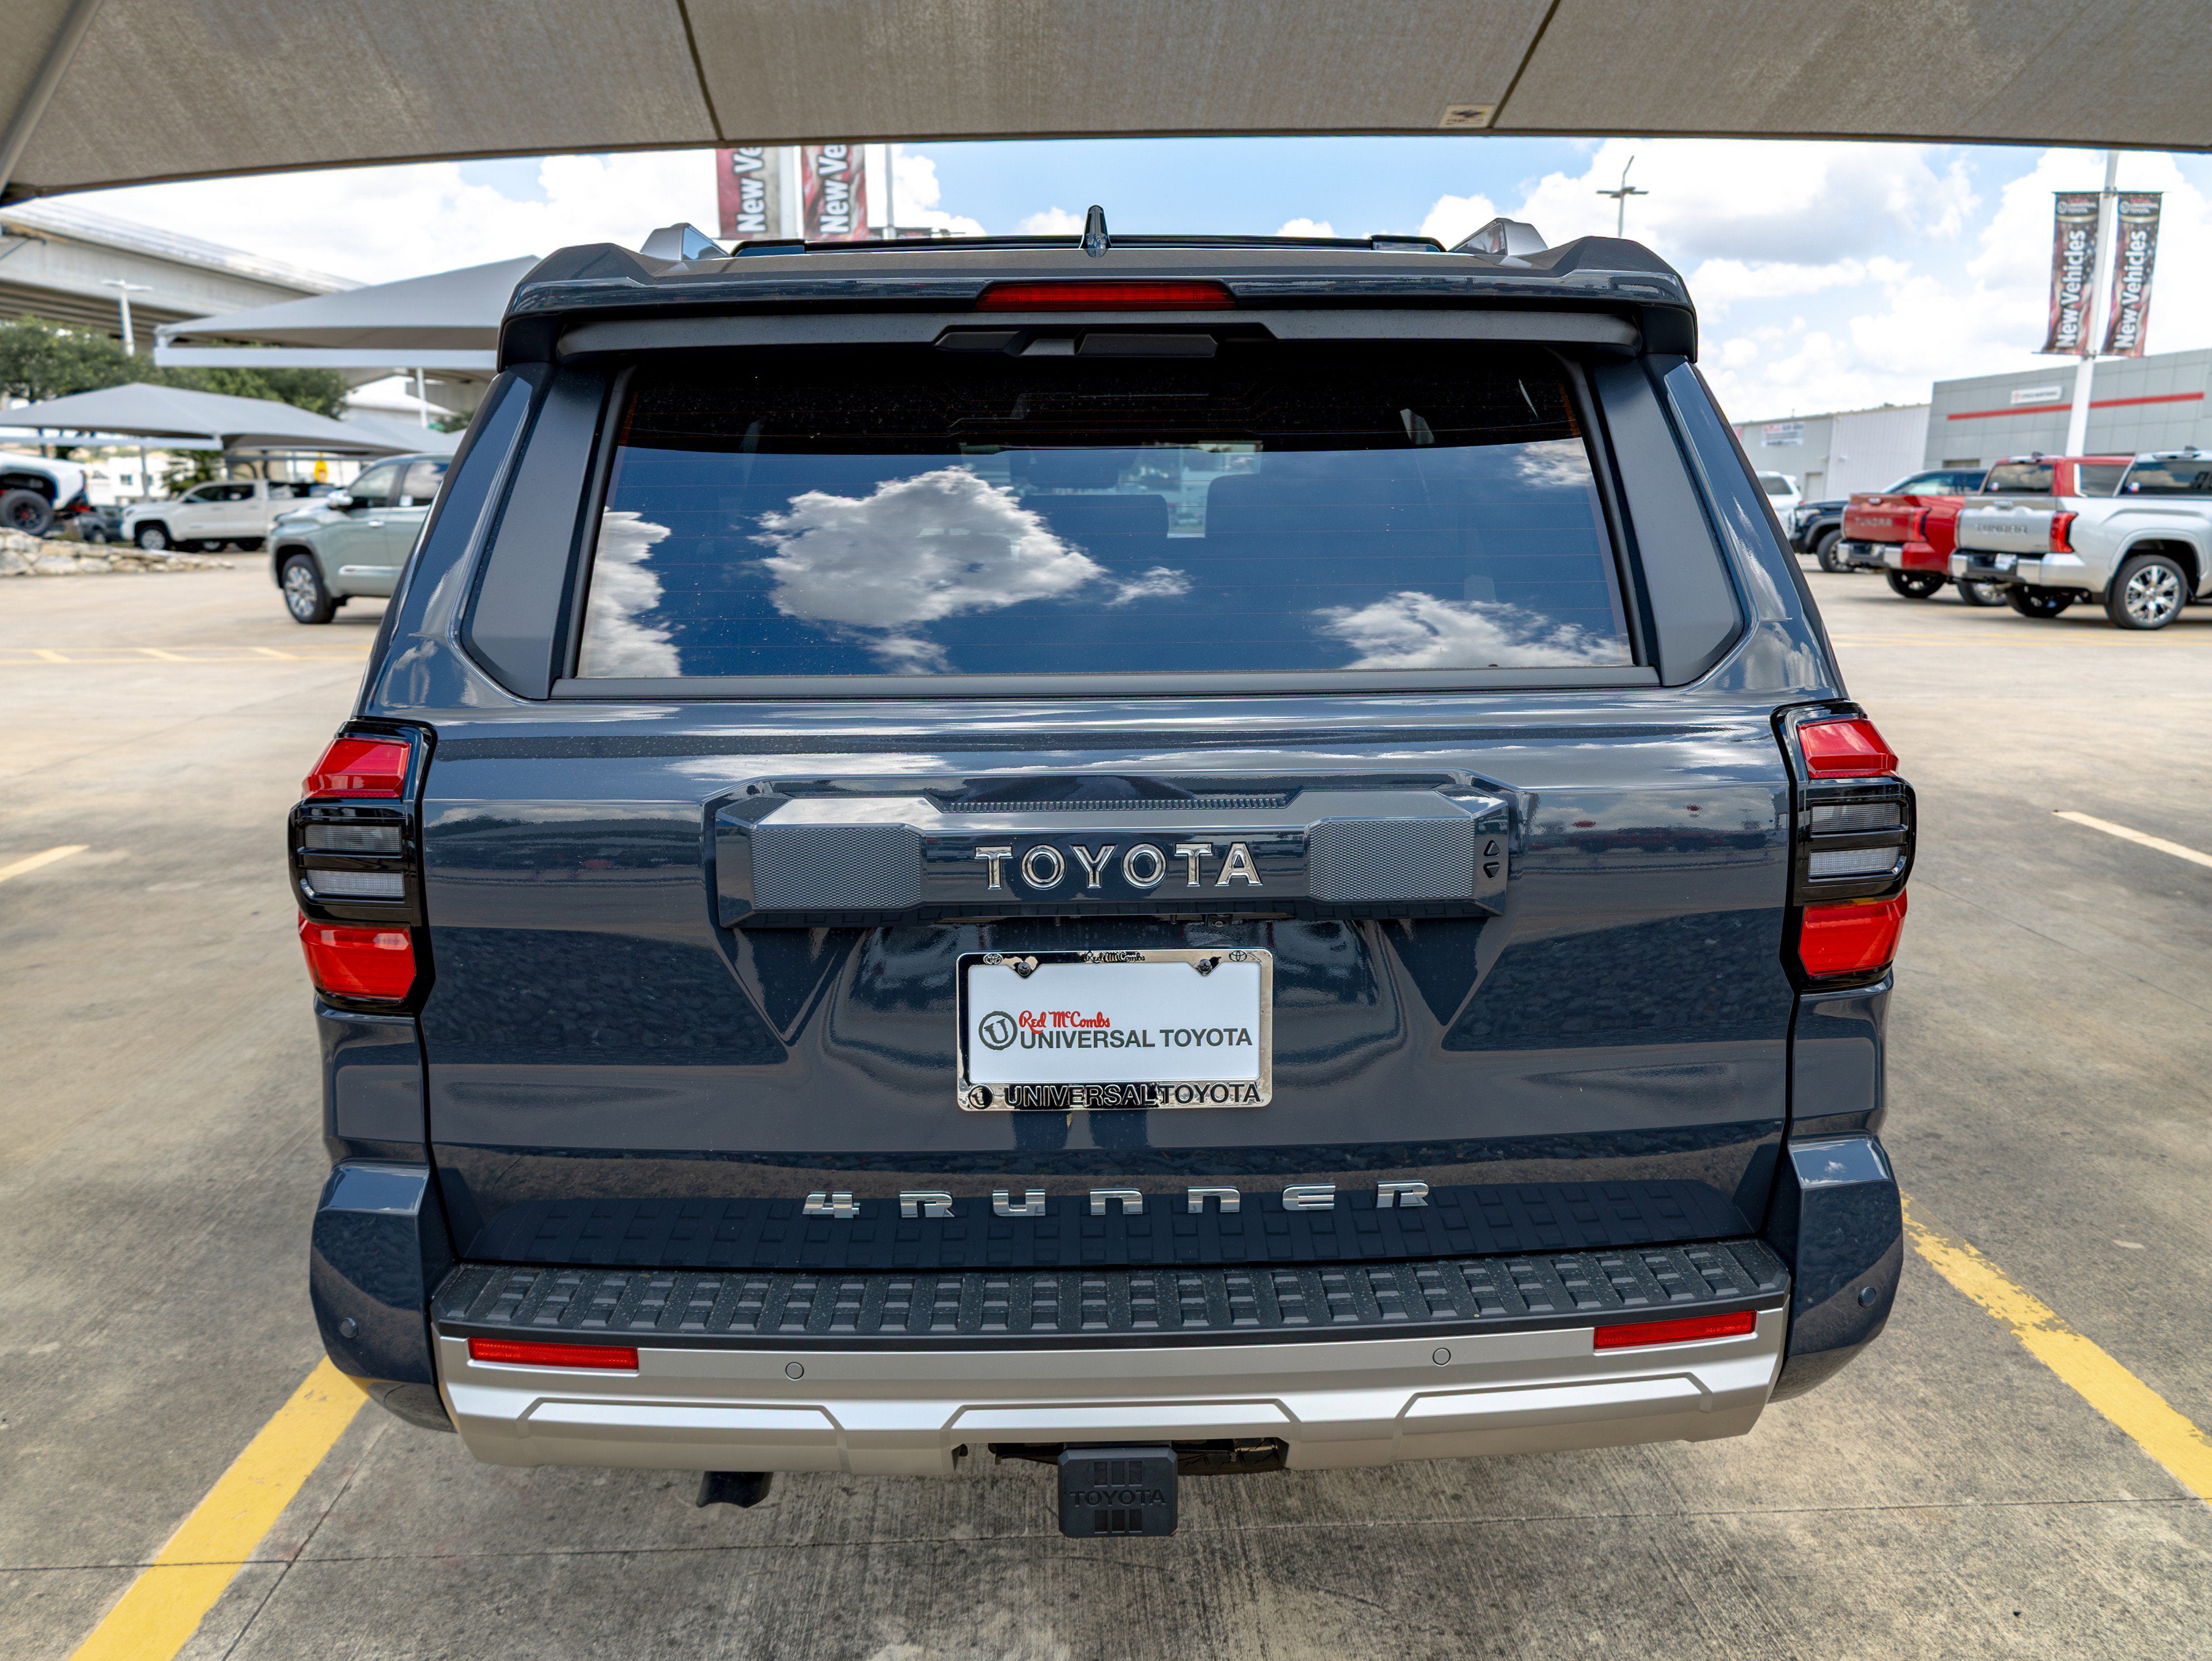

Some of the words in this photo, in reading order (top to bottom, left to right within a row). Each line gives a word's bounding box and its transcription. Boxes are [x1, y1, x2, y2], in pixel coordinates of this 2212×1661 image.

[737, 178, 766, 232] New
[820, 179, 849, 233] New
[2061, 230, 2086, 305] Vehicles
[2122, 230, 2147, 305] Vehicles
[2055, 309, 2078, 348] New
[2113, 309, 2137, 349] New
[974, 842, 1263, 890] TOYOTA
[1019, 1011, 1047, 1034] Red
[1048, 1011, 1111, 1028] McCombs
[1020, 1029, 1156, 1049] UNIVERSAL
[1160, 1028, 1253, 1047] TOYOTA
[1003, 1084, 1158, 1107] UNIVERSAL
[1158, 1081, 1262, 1104] TOYOTA
[802, 1179, 1429, 1219] 4RUNNER
[1070, 1489, 1166, 1507] TOYOTA
